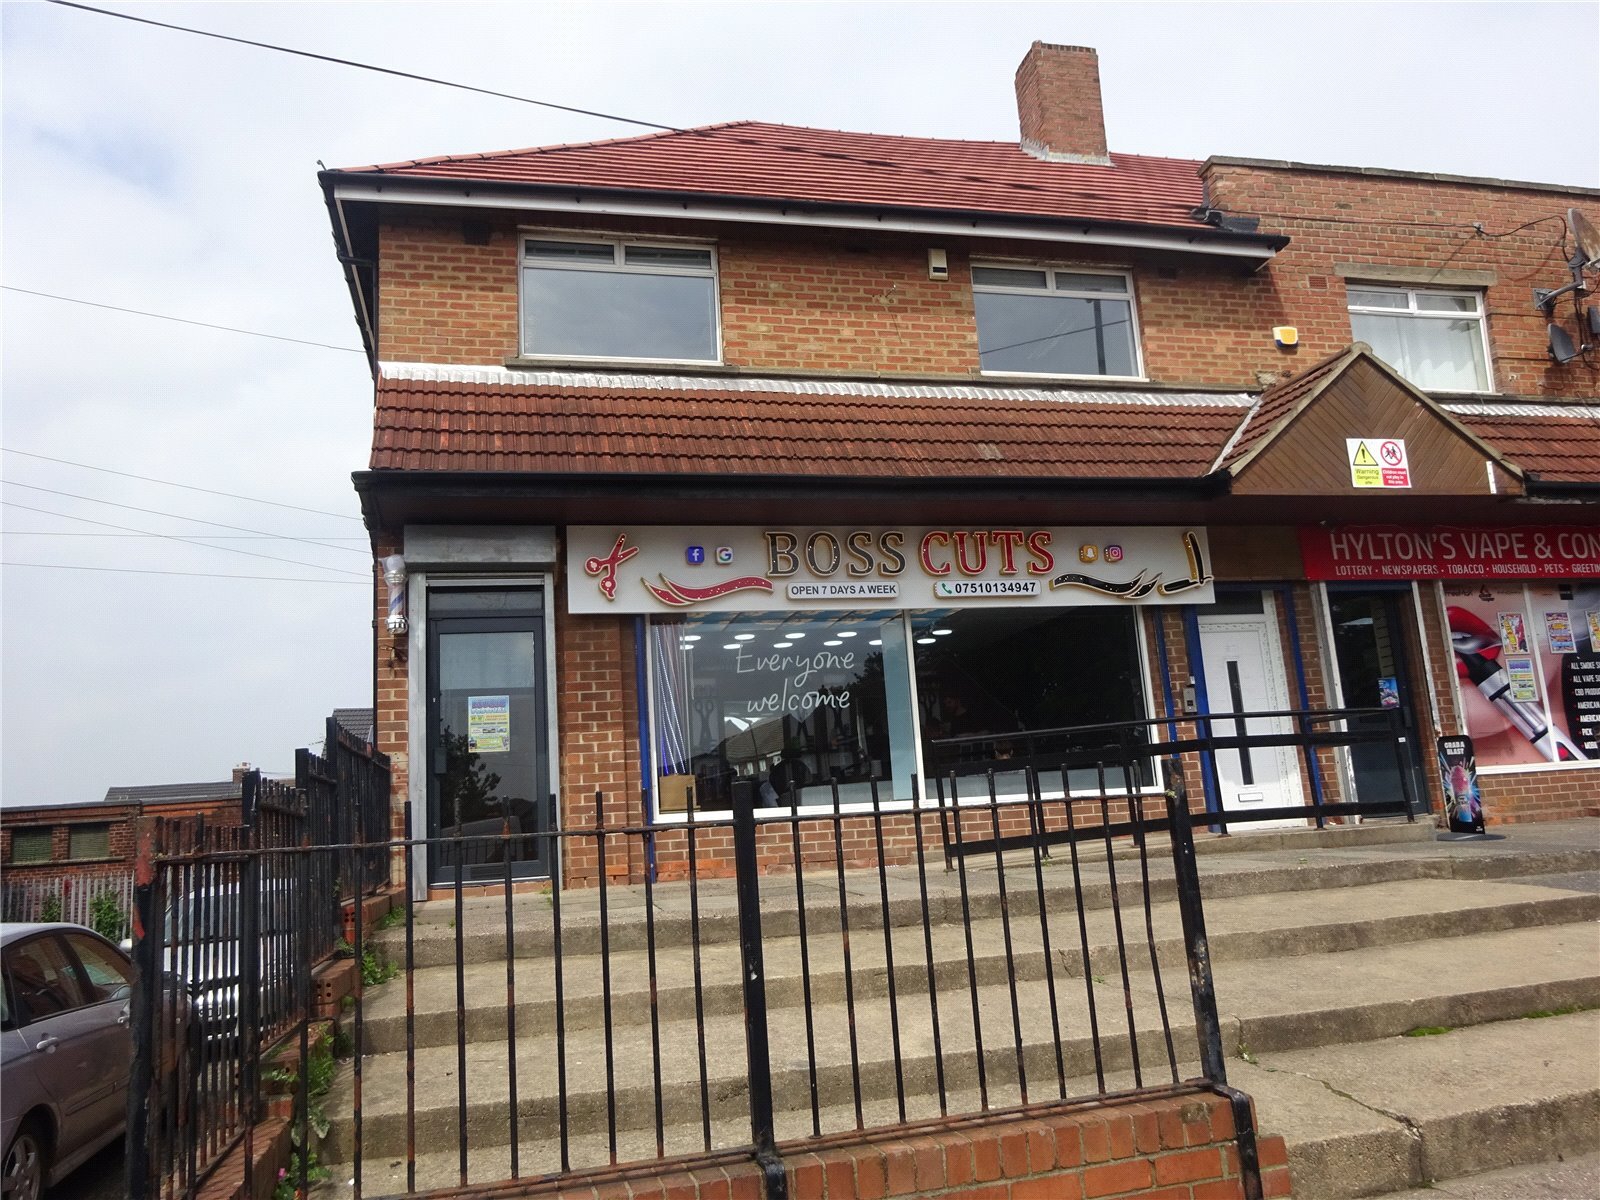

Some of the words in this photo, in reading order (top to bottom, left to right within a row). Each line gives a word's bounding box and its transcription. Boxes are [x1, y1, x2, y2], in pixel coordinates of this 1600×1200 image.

[764, 531, 906, 577] BOSS
[918, 530, 1055, 577] CUTS
[1330, 533, 1456, 560] HYLTON'S
[1461, 533, 1528, 559] VAPE
[1533, 533, 1553, 559] &
[1335, 565, 1372, 576] LOTTERY
[1382, 564, 1439, 575] NEWSPAPERS
[1447, 564, 1484, 574] TOBACCO
[1492, 564, 1537, 574] HOUSEHOLD
[1544, 563, 1564, 574] PETS
[791, 586, 819, 595] OPEN
[822, 586, 827, 595] 7
[830, 585, 856, 595] DAYS
[858, 585, 866, 594] A
[867, 585, 897, 594] WEEK
[955, 582, 1036, 594] 07510134947
[736, 640, 855, 688] Everyone
[1582, 674, 1595, 683] VAPE
[747, 678, 851, 713] welcome
